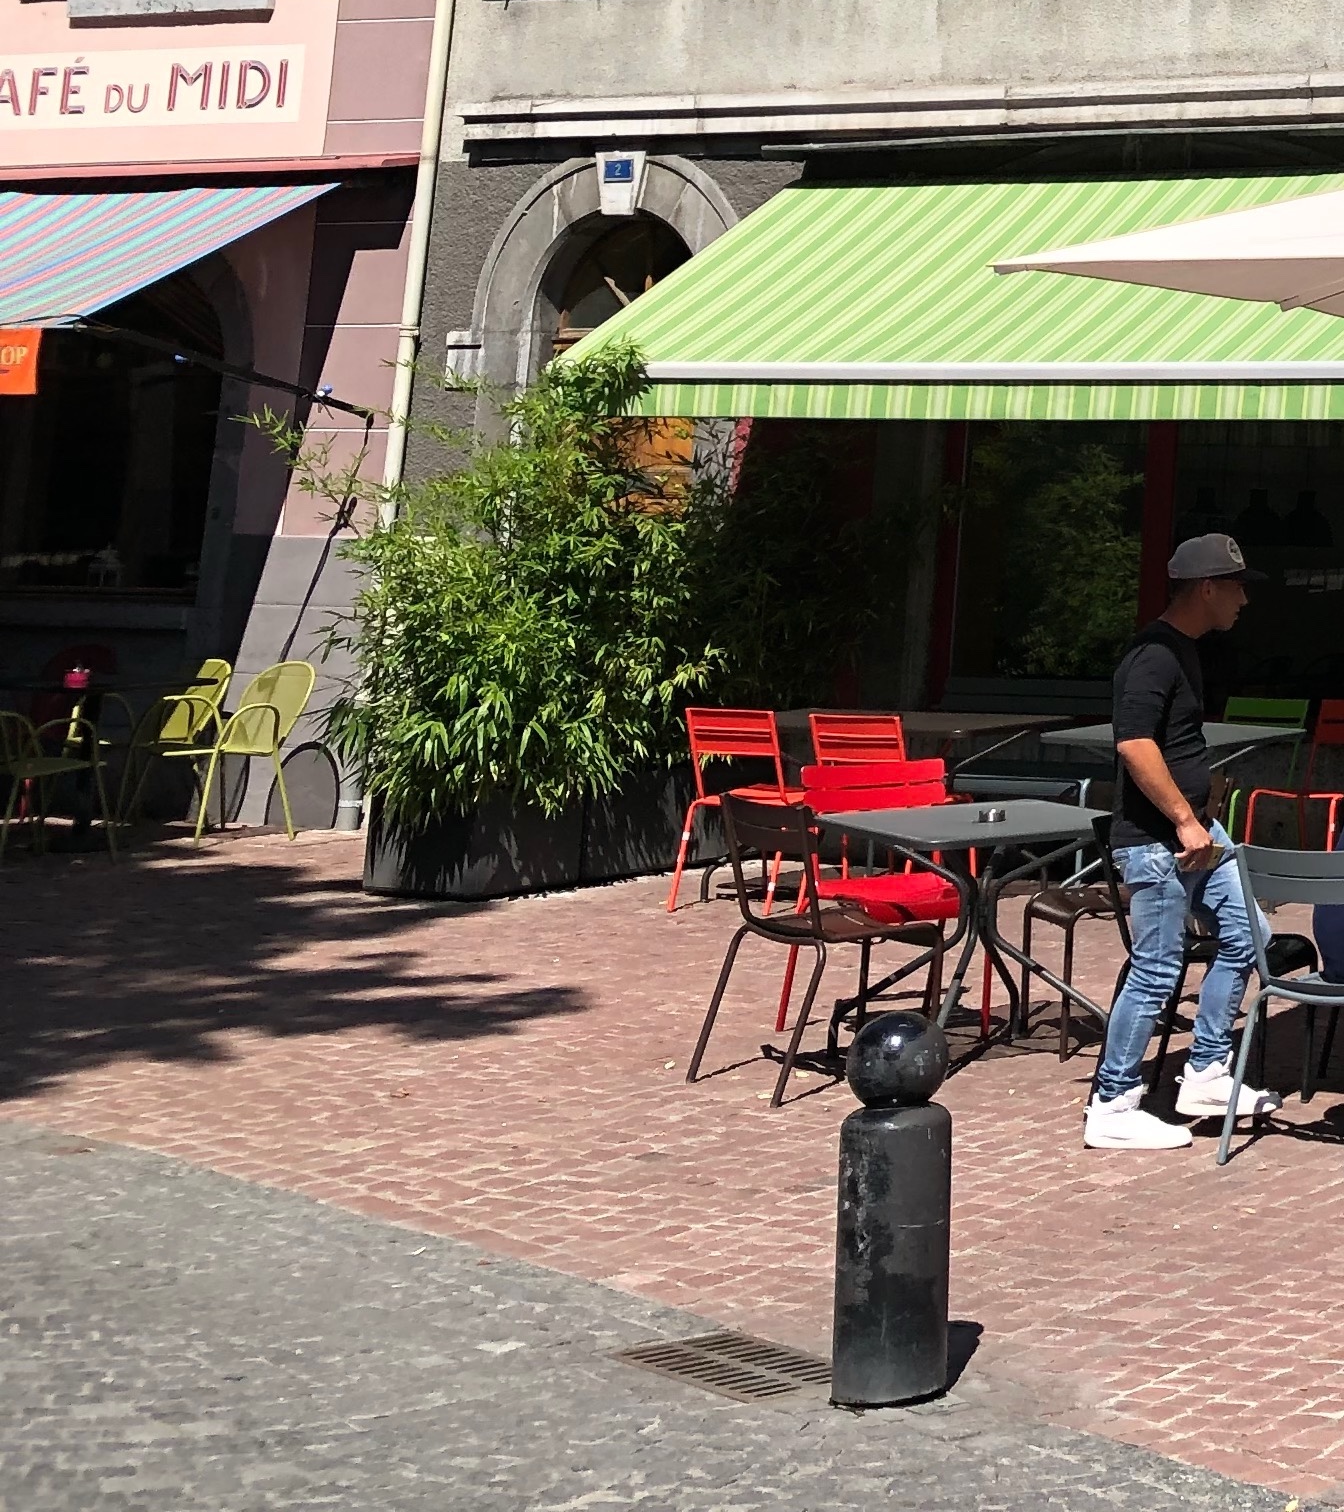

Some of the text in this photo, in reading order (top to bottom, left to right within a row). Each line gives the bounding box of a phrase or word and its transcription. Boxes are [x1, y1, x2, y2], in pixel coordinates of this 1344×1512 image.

[0, 55, 290, 117] AFÉ DU MIDI
